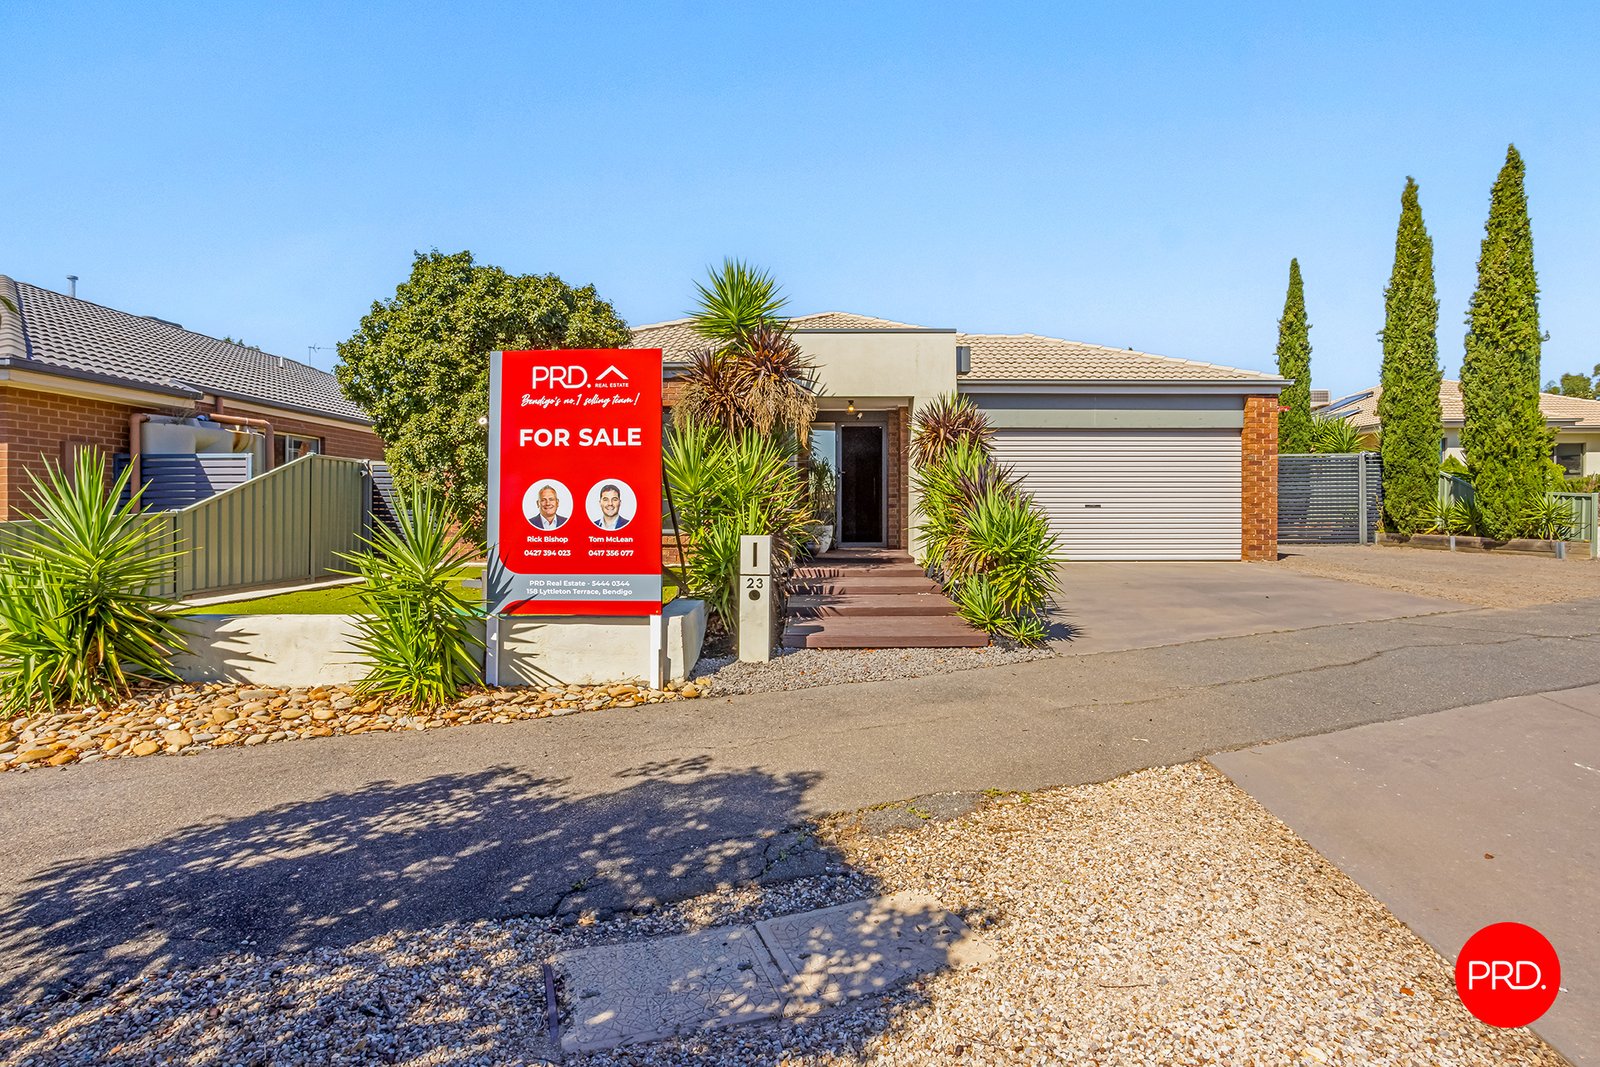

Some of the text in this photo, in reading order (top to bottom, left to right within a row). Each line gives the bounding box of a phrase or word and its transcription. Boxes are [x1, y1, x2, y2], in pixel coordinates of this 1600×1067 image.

[532, 365, 592, 390] PRD.
[520, 393, 561, 409] Bendigo's
[583, 394, 611, 408] selling
[519, 427, 642, 447] FOR SALE
[543, 536, 569, 544] Bishop
[523, 549, 571, 557] 0427 394 023
[588, 549, 634, 557] 0417 356 077
[746, 577, 764, 589] 23
[539, 588, 572, 596] Lyttleton
[573, 588, 601, 596] Terrace,
[602, 588, 633, 597] Bendigo
